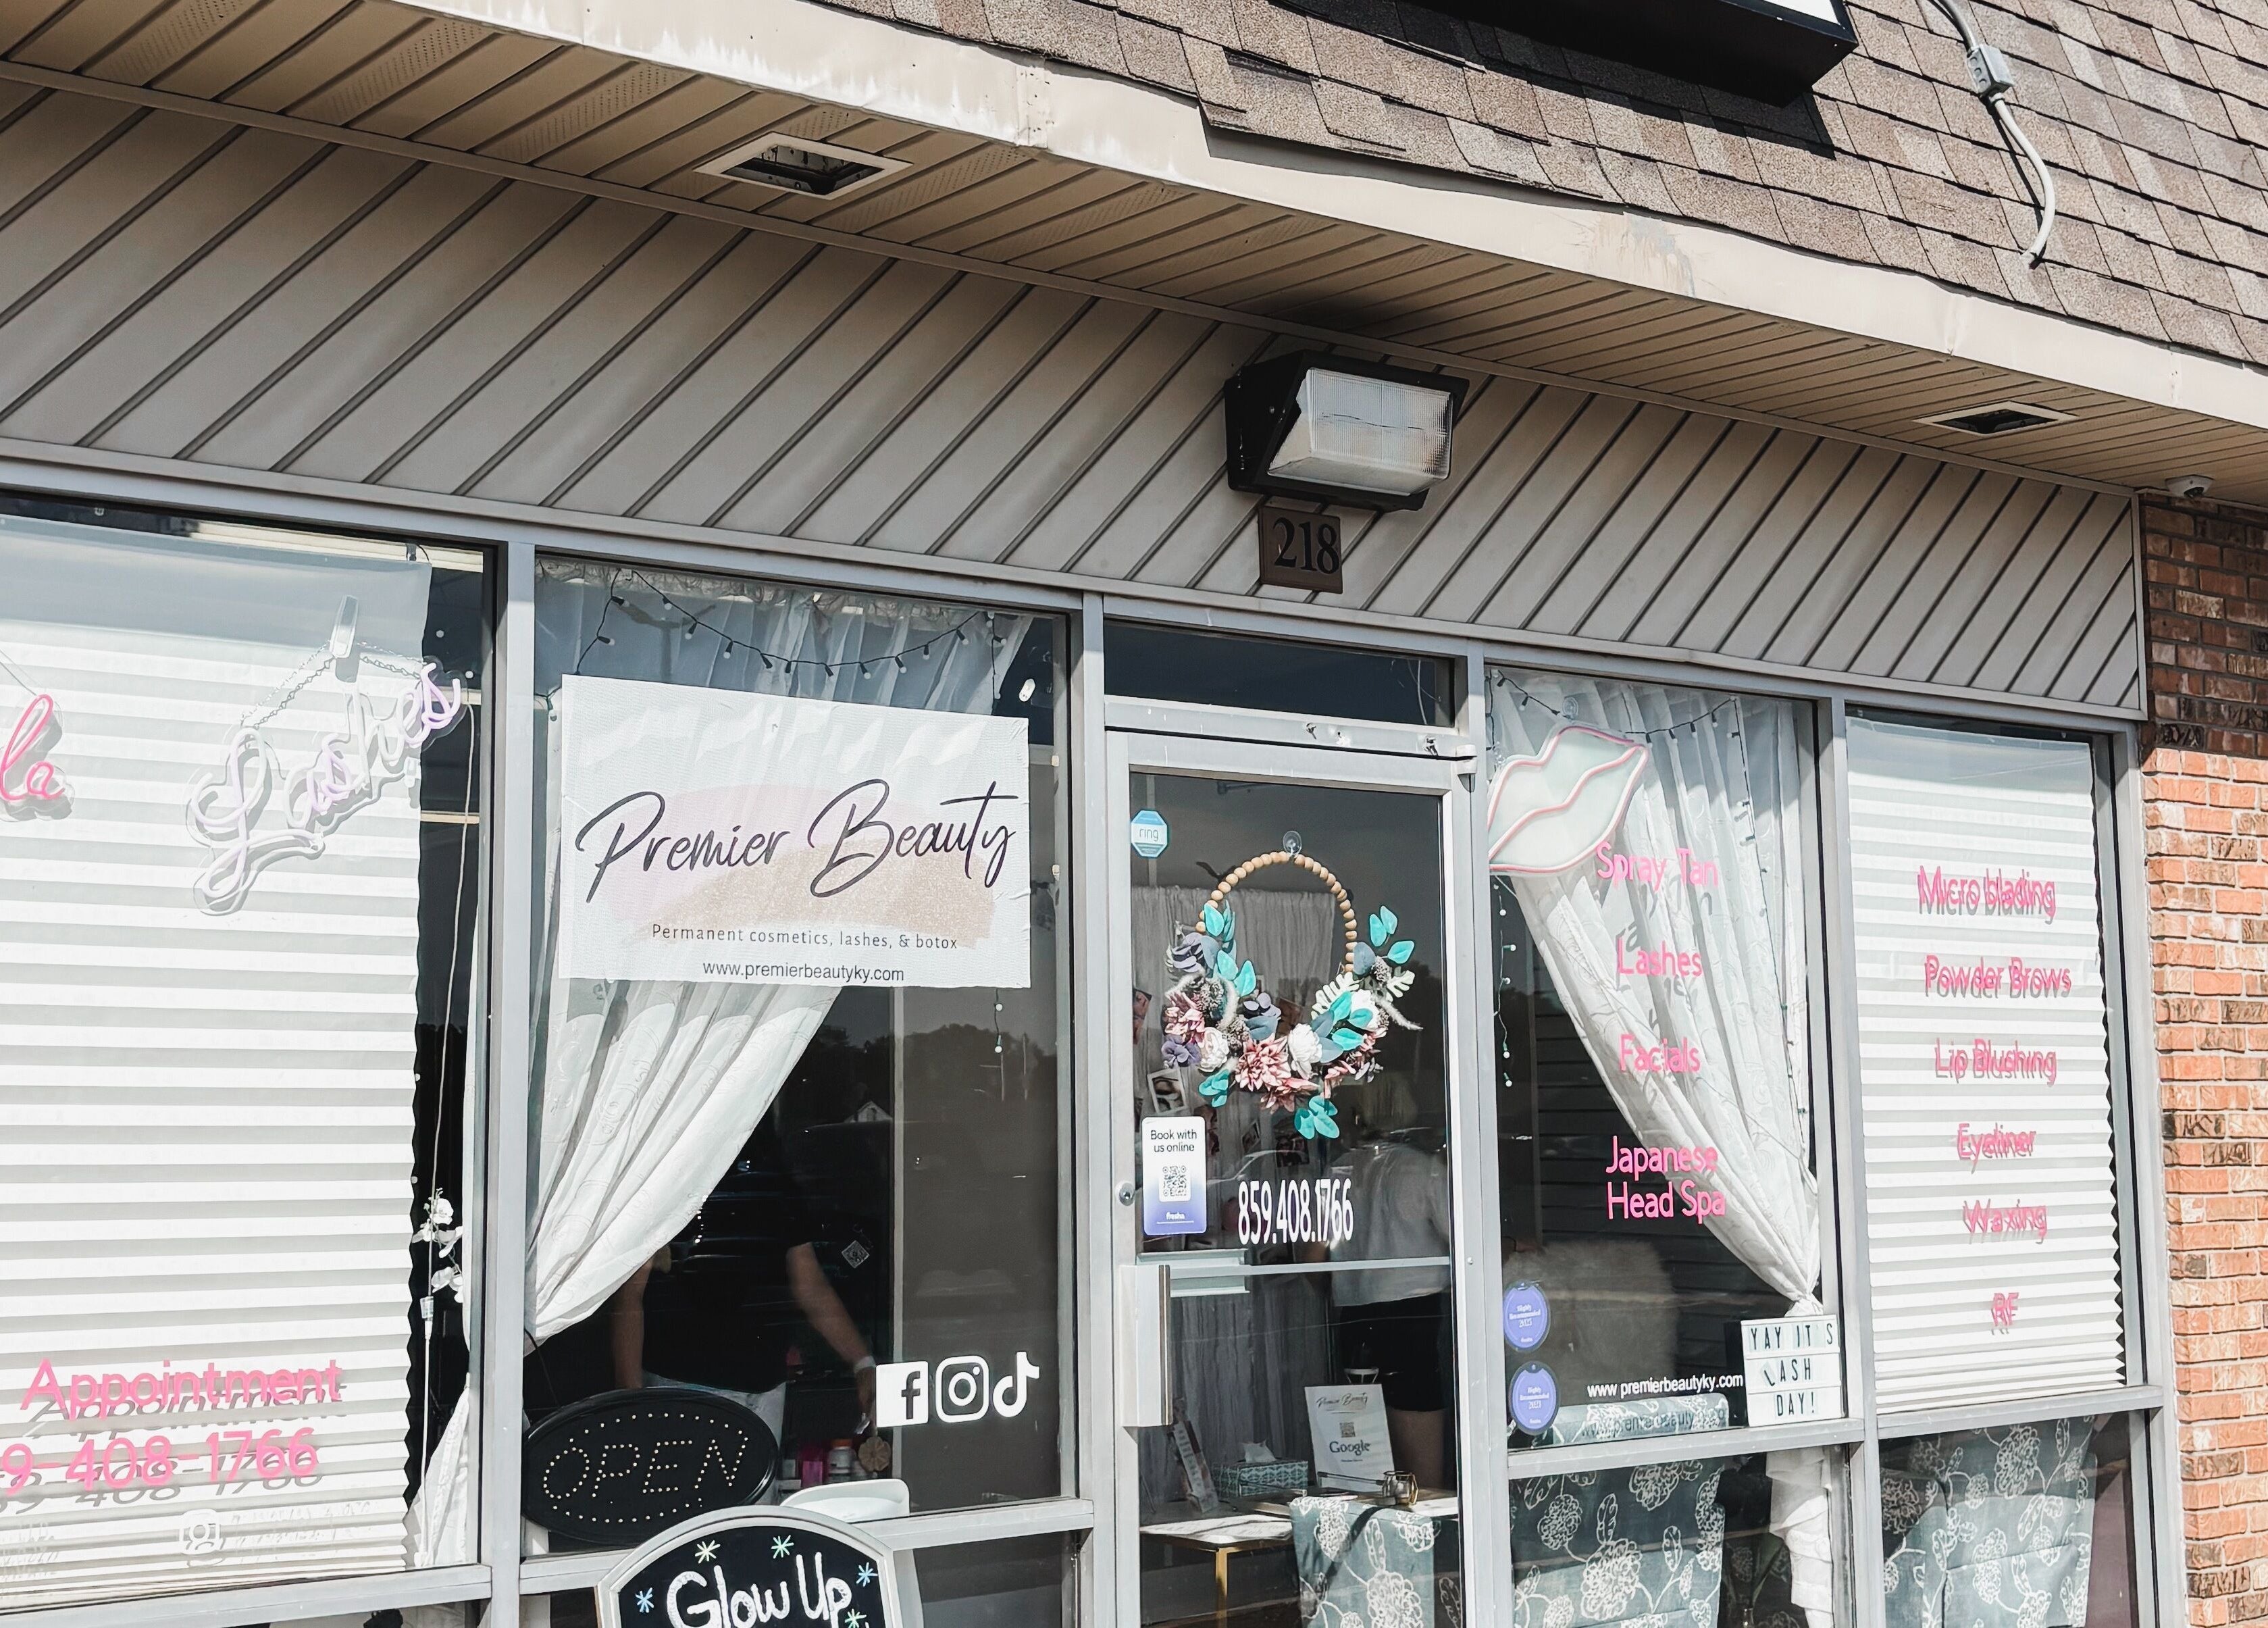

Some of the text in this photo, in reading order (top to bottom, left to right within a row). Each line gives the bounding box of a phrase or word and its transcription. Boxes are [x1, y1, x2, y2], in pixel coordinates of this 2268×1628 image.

[1273, 517, 1340, 574] 218
[191, 663, 461, 898] Lashes
[575, 779, 1019, 903] Premier Beauty
[1139, 828, 1159, 842] ring
[1595, 841, 1718, 891] Spray Tan
[1917, 865, 2056, 919] Micro blading
[652, 924, 958, 950] Permanent cosmetics, lashes, & botox
[1616, 938, 1703, 977] Lashes
[702, 961, 904, 983] www.premierbeautyky.com
[1925, 955, 2072, 993] Powder Brows
[1618, 1034, 1701, 1073] Facials
[1934, 1038, 2057, 1085] Lip Blushing
[1150, 1129, 1197, 1140] Book with
[1154, 1142, 1195, 1152] us online
[1957, 1122, 2036, 1167] Eyeliner
[1605, 1136, 1718, 1181] Japanese
[1237, 1177, 1354, 1245] 859.408.1766
[1606, 1180, 1726, 1224] Head Spa
[1962, 1199, 2048, 1241] Waxing
[1751, 1326, 1781, 1350] YAY
[20, 1358, 342, 1421] Appointment
[1763, 1358, 1811, 1386] LASH
[1776, 1392, 1815, 1417] DAY!
[542, 1436, 748, 1500] OPEN
[1329, 1440, 1371, 1456] Google
[666, 1552, 852, 1628] Glow Up
